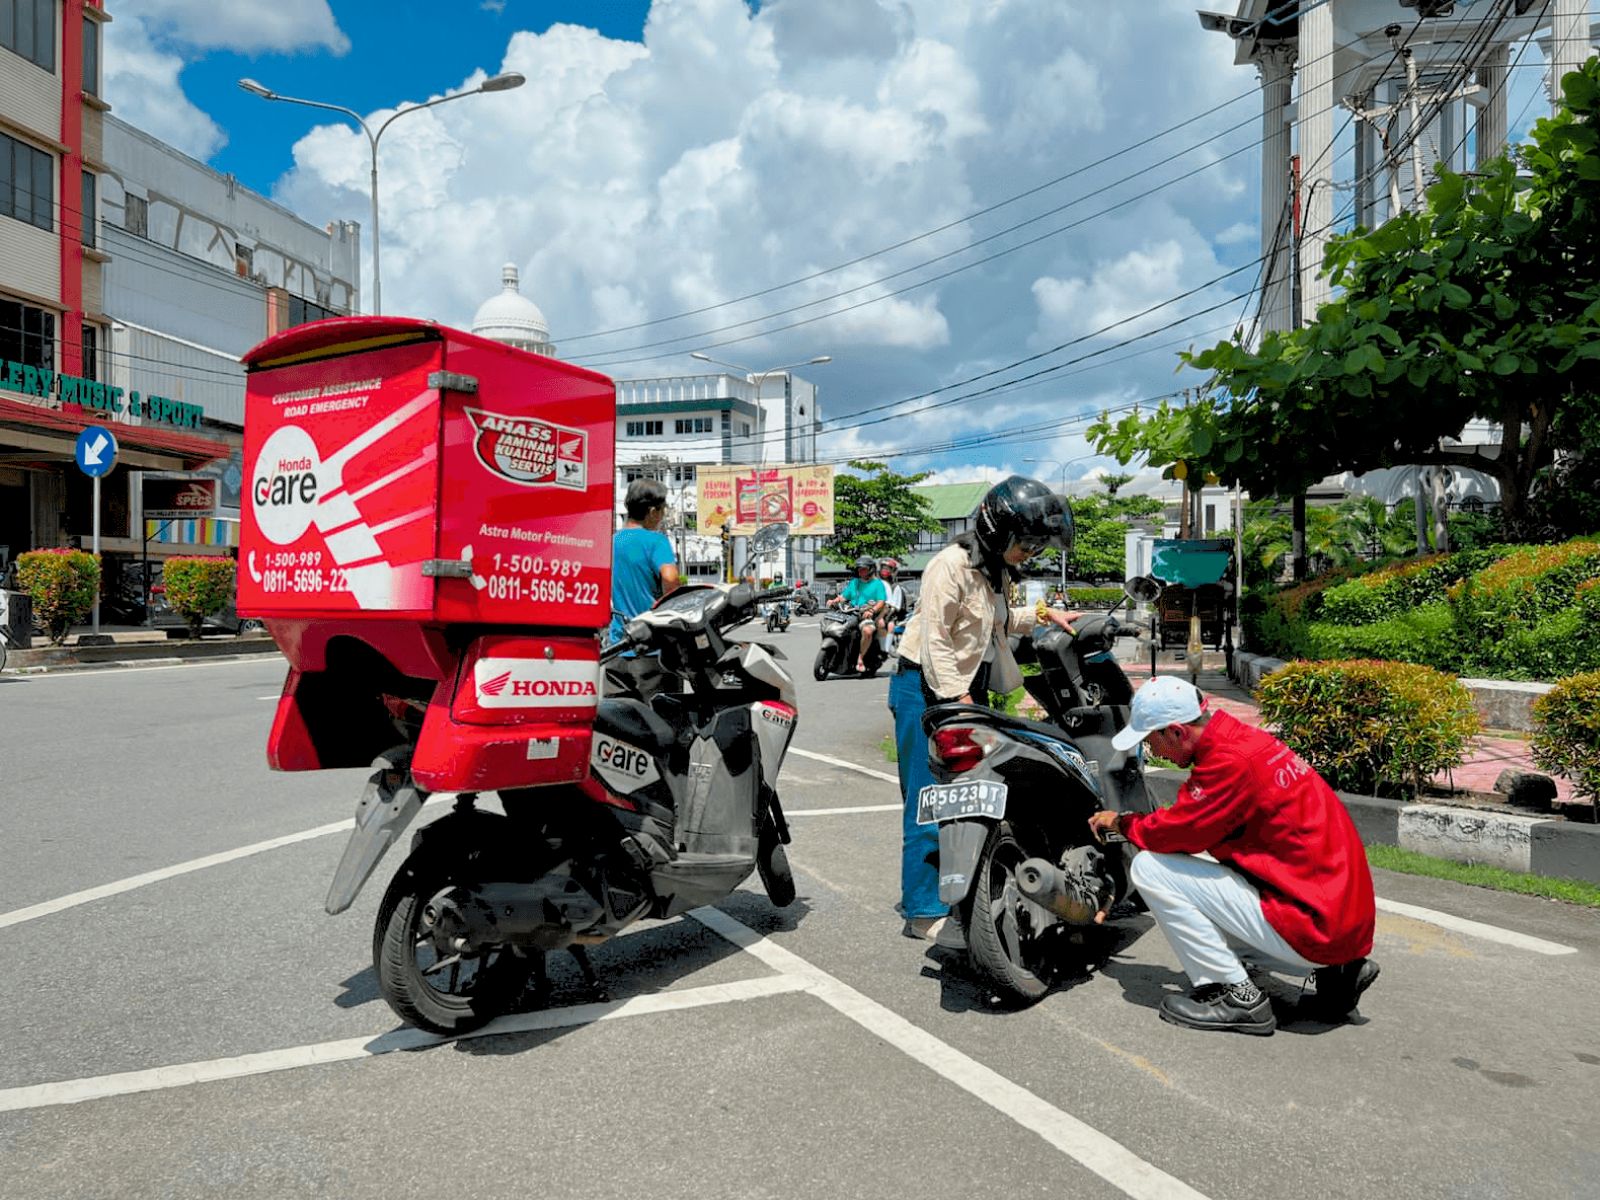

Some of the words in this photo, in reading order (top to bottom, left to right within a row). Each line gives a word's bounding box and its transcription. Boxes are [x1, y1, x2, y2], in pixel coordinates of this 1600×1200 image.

[59, 374, 124, 413] MUSIC
[130, 391, 141, 417] &
[149, 395, 204, 429] SPORT
[272, 387, 320, 405] CUSTOMER
[321, 378, 382, 398] ASSISTANCE
[283, 404, 309, 418] ROAD
[309, 395, 369, 415] EMERGENCY
[482, 417, 552, 441] AHASS
[495, 444, 555, 465] KUALITAS
[497, 433, 556, 454] JAMINAN
[278, 457, 312, 472] Honda
[510, 458, 554, 475] SERVIS
[176, 493, 213, 506] SPECS
[479, 523, 509, 539] Astra
[510, 527, 543, 543] Motor
[543, 531, 595, 548] Pattimura
[265, 551, 321, 567] 1-500-989
[493, 553, 582, 578] 1-500-989
[488, 574, 599, 605] 0811-5696-222
[512, 680, 597, 697] HONDA
